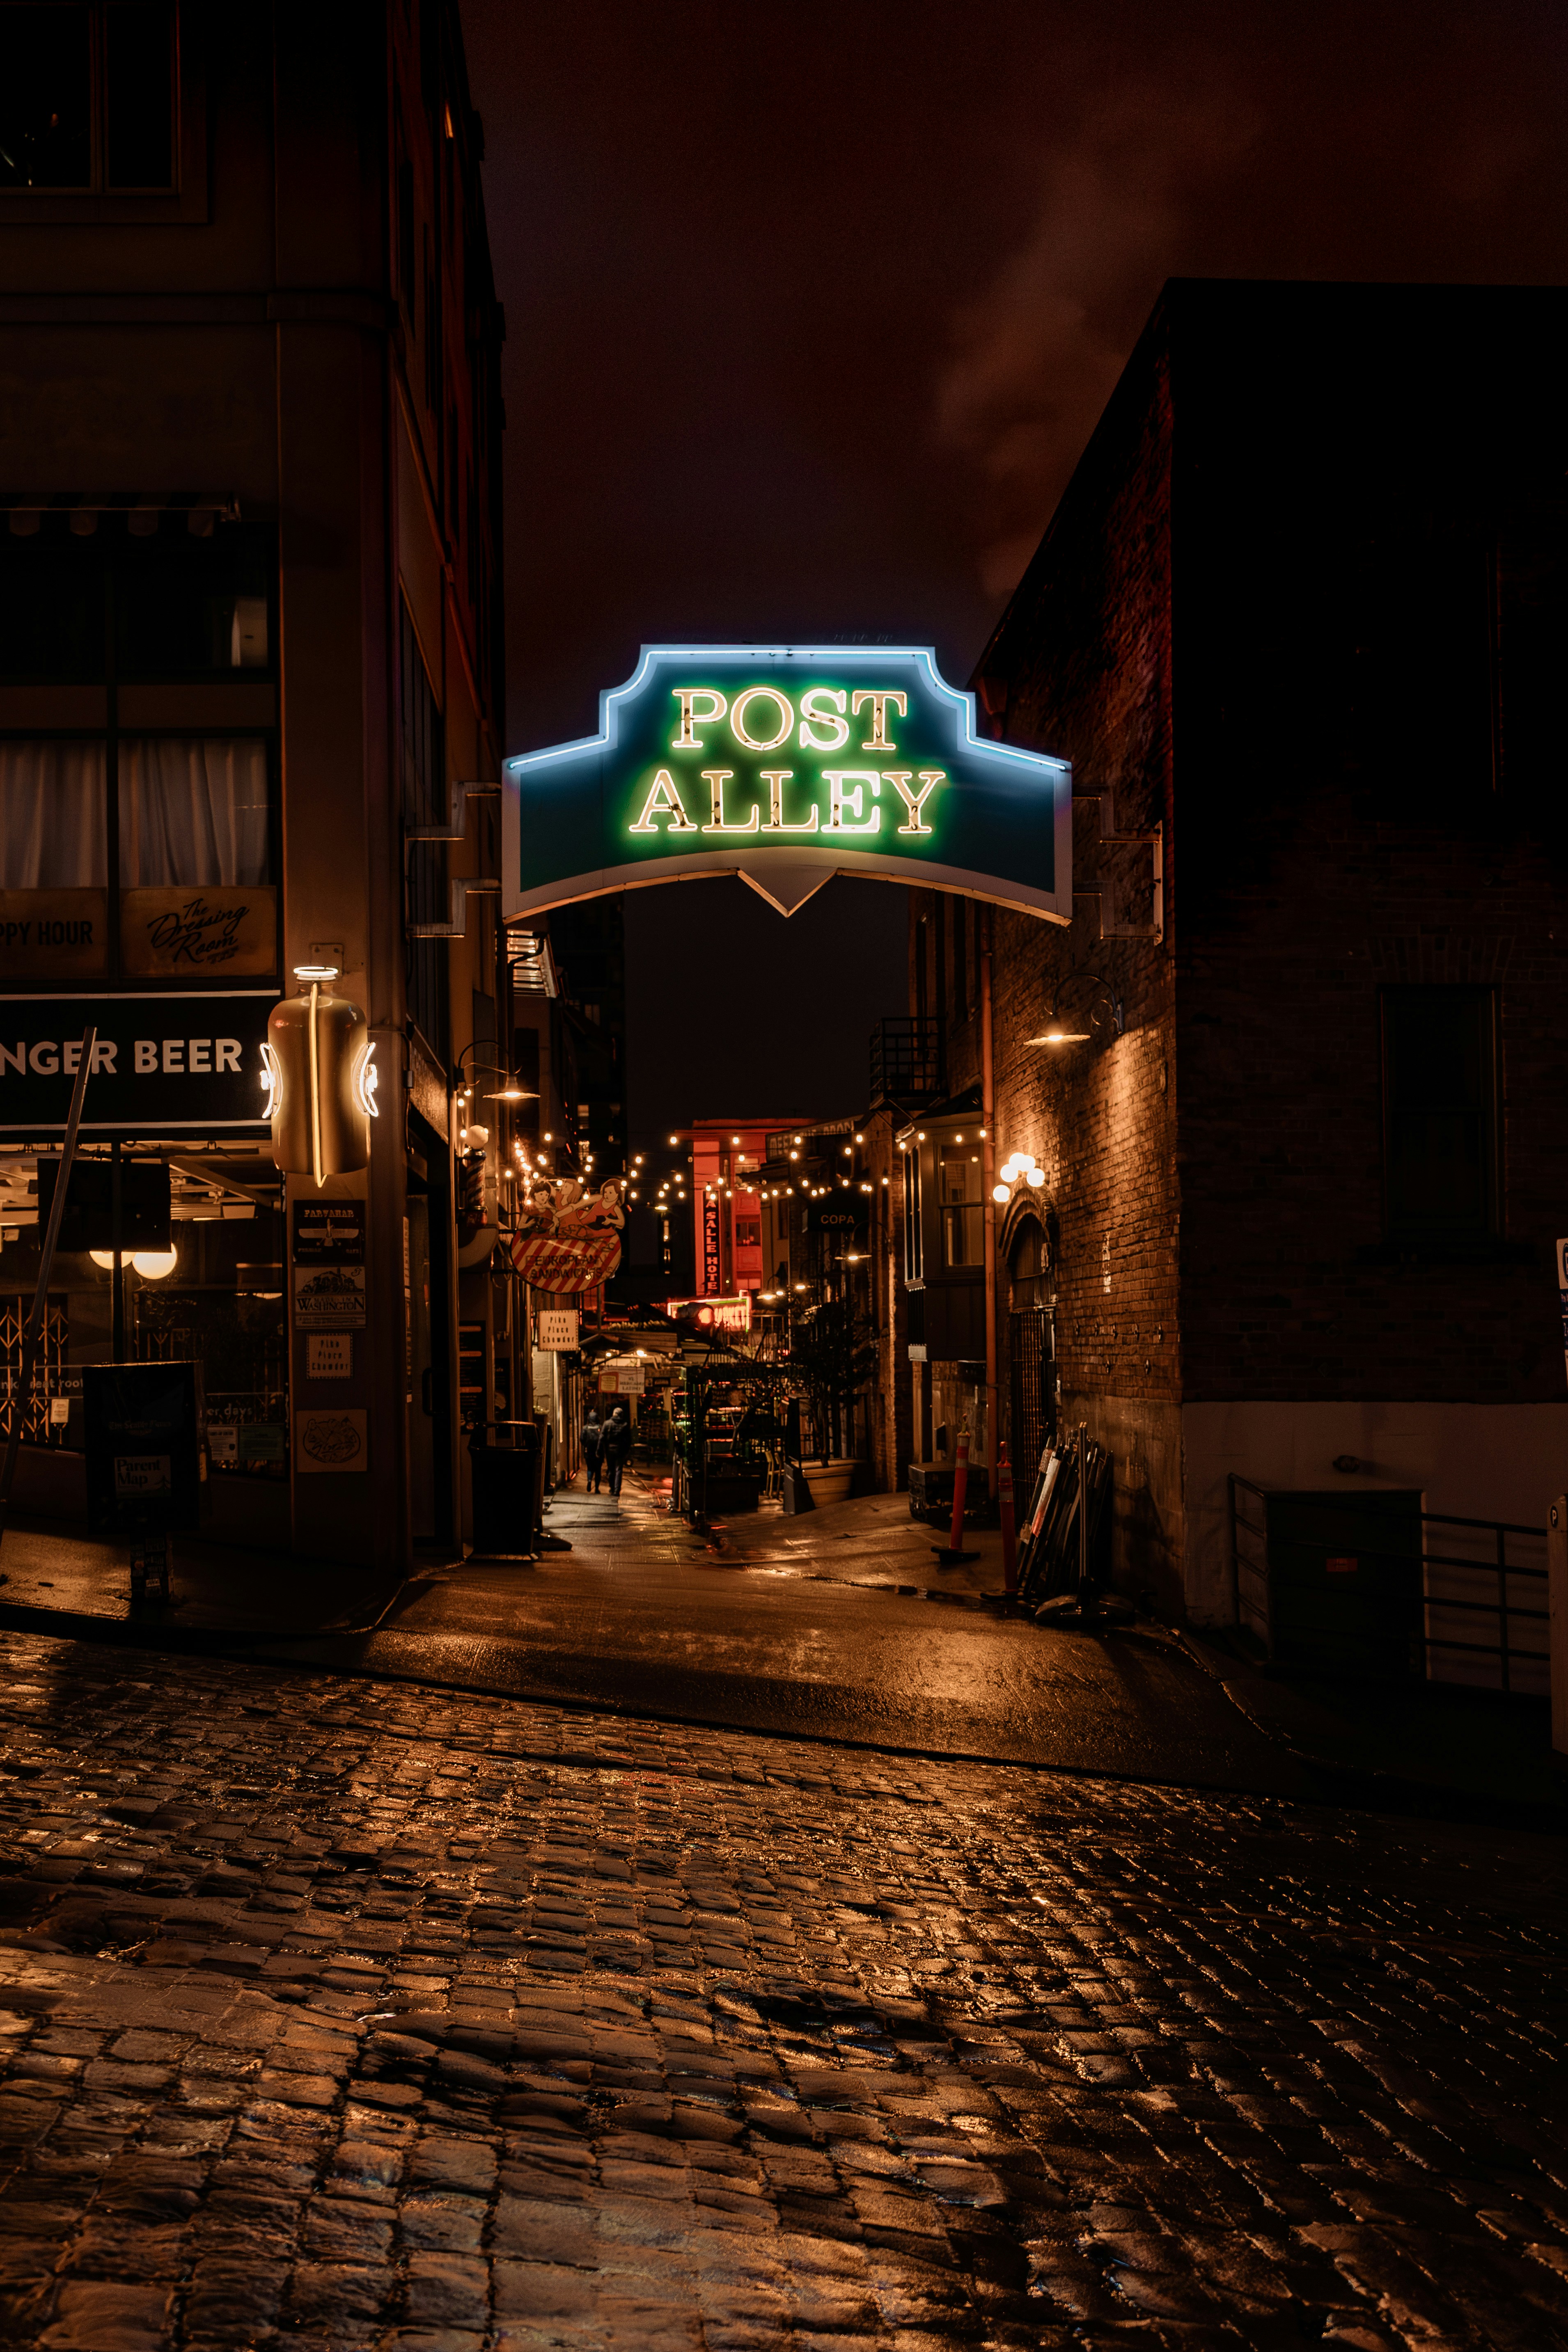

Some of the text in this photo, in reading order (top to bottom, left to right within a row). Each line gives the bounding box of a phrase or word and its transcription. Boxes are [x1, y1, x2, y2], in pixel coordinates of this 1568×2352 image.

[672, 687, 907, 751] POST
[629, 769, 946, 834] ALLEY
[183, 898, 209, 919] The
[38, 921, 93, 945] HOUR
[147, 906, 250, 948] Dressing
[169, 932, 238, 963] Room
[0, 1038, 242, 1075] NGER BEER
[821, 1214, 855, 1224] COPA
[706, 1212, 717, 1253] SALLE
[297, 1297, 364, 1311] WASHINGTON
[321, 1339, 339, 1348] Pike
[318, 1350, 342, 1359] Place
[312, 1362, 348, 1370] Chowder
[224, 1403, 253, 1420] days
[117, 1458, 161, 1472] Parent
[118, 1472, 148, 1489] Map
